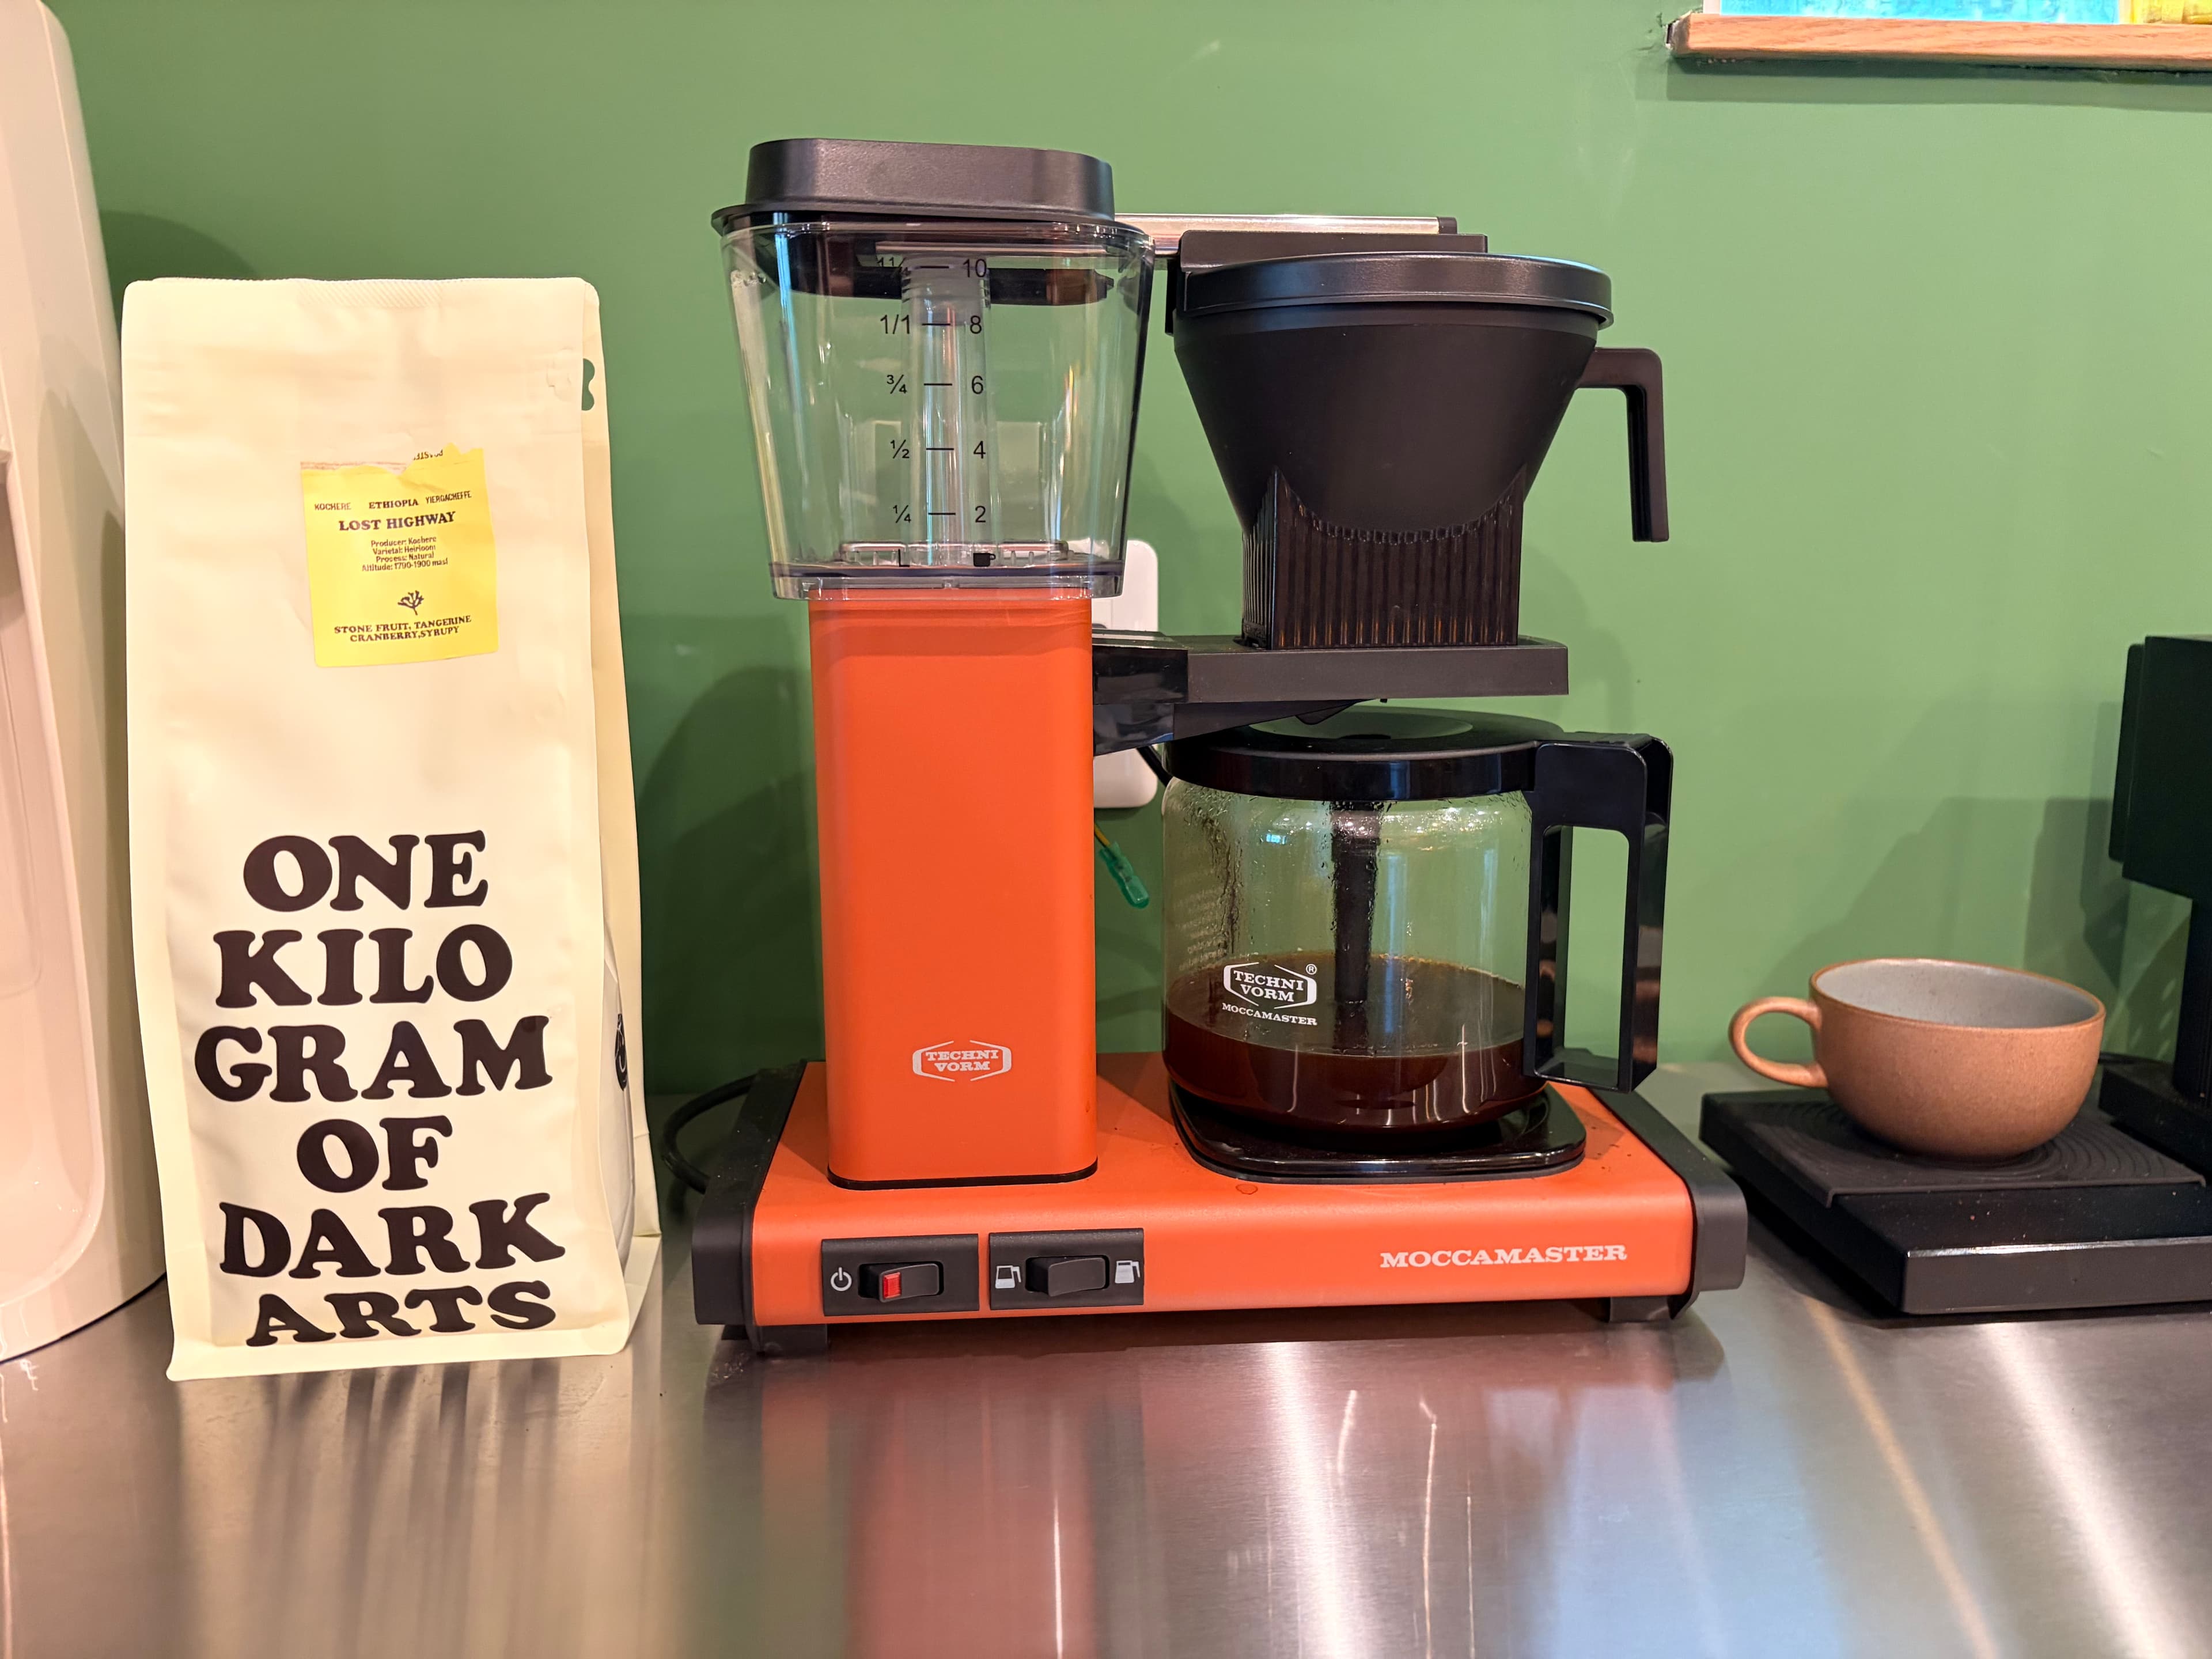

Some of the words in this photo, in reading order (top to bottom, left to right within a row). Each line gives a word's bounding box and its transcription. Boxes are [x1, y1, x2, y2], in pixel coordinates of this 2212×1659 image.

[963, 258, 987, 278] 10
[880, 315, 910, 335] 1/1
[970, 315, 982, 334] 8
[971, 376, 984, 395] 6
[973, 441, 986, 459] 4
[314, 502, 351, 510] KOCHERE
[369, 498, 419, 509] ETHIOPIA
[975, 505, 986, 522] 2
[339, 519, 381, 531] LOST
[387, 511, 456, 529] HIGHWAY
[371, 539, 407, 547] Producer:
[408, 551, 434, 560] Natural
[898, 549, 910, 567] L
[362, 563, 393, 572] Altitude:
[334, 626, 373, 634] STONE
[376, 622, 411, 632] FRUIT,
[414, 615, 472, 630] TANGERINE
[243, 830, 488, 912] ONE
[213, 924, 513, 1008] KILO
[1233, 970, 1304, 991] TECHNI
[1240, 984, 1295, 1002] VORM
[1222, 1002, 1317, 1026] MOCCAMASTER
[194, 1015, 554, 1103] GRAM
[926, 1050, 998, 1061] TECHNI
[934, 1062, 990, 1071] VORM
[297, 1115, 453, 1193] OF
[219, 1192, 566, 1279] DARK
[1380, 1244, 1627, 1268] MOCCAMASTER
[245, 1280, 556, 1346] ARTS
